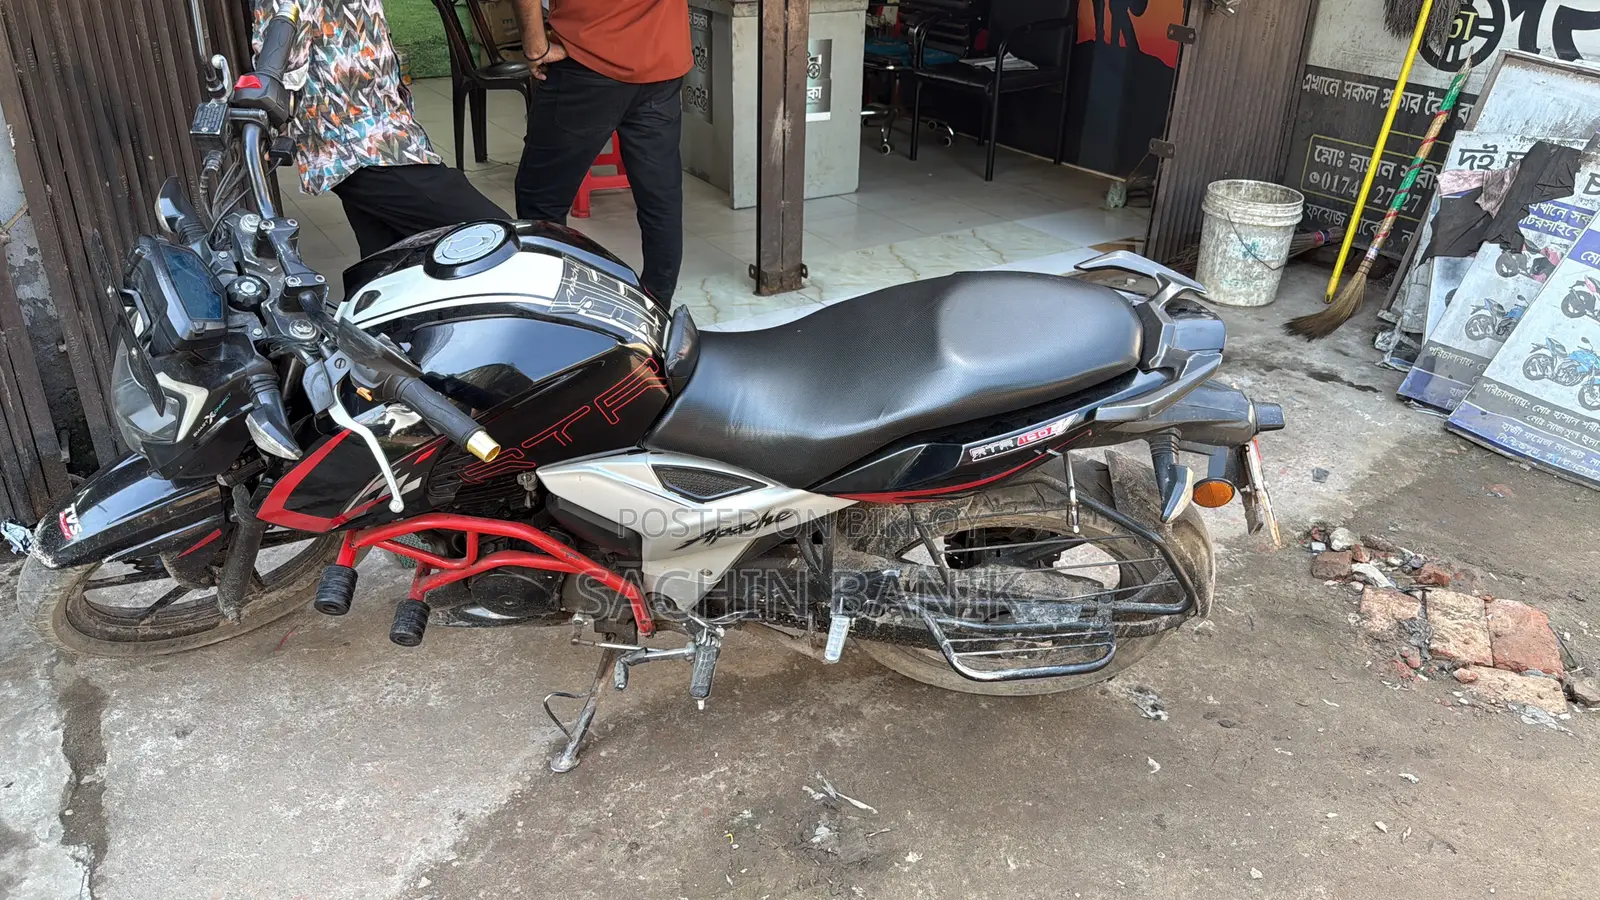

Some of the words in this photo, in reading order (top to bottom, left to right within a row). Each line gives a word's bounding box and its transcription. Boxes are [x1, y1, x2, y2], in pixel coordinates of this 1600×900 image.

[1302, 73, 1341, 98] এখানে
[1343, 80, 1380, 106] সকল
[1314, 144, 1345, 168] মোঃ
[64, 502, 83, 536] TVS
[670, 506, 795, 551] Apache
